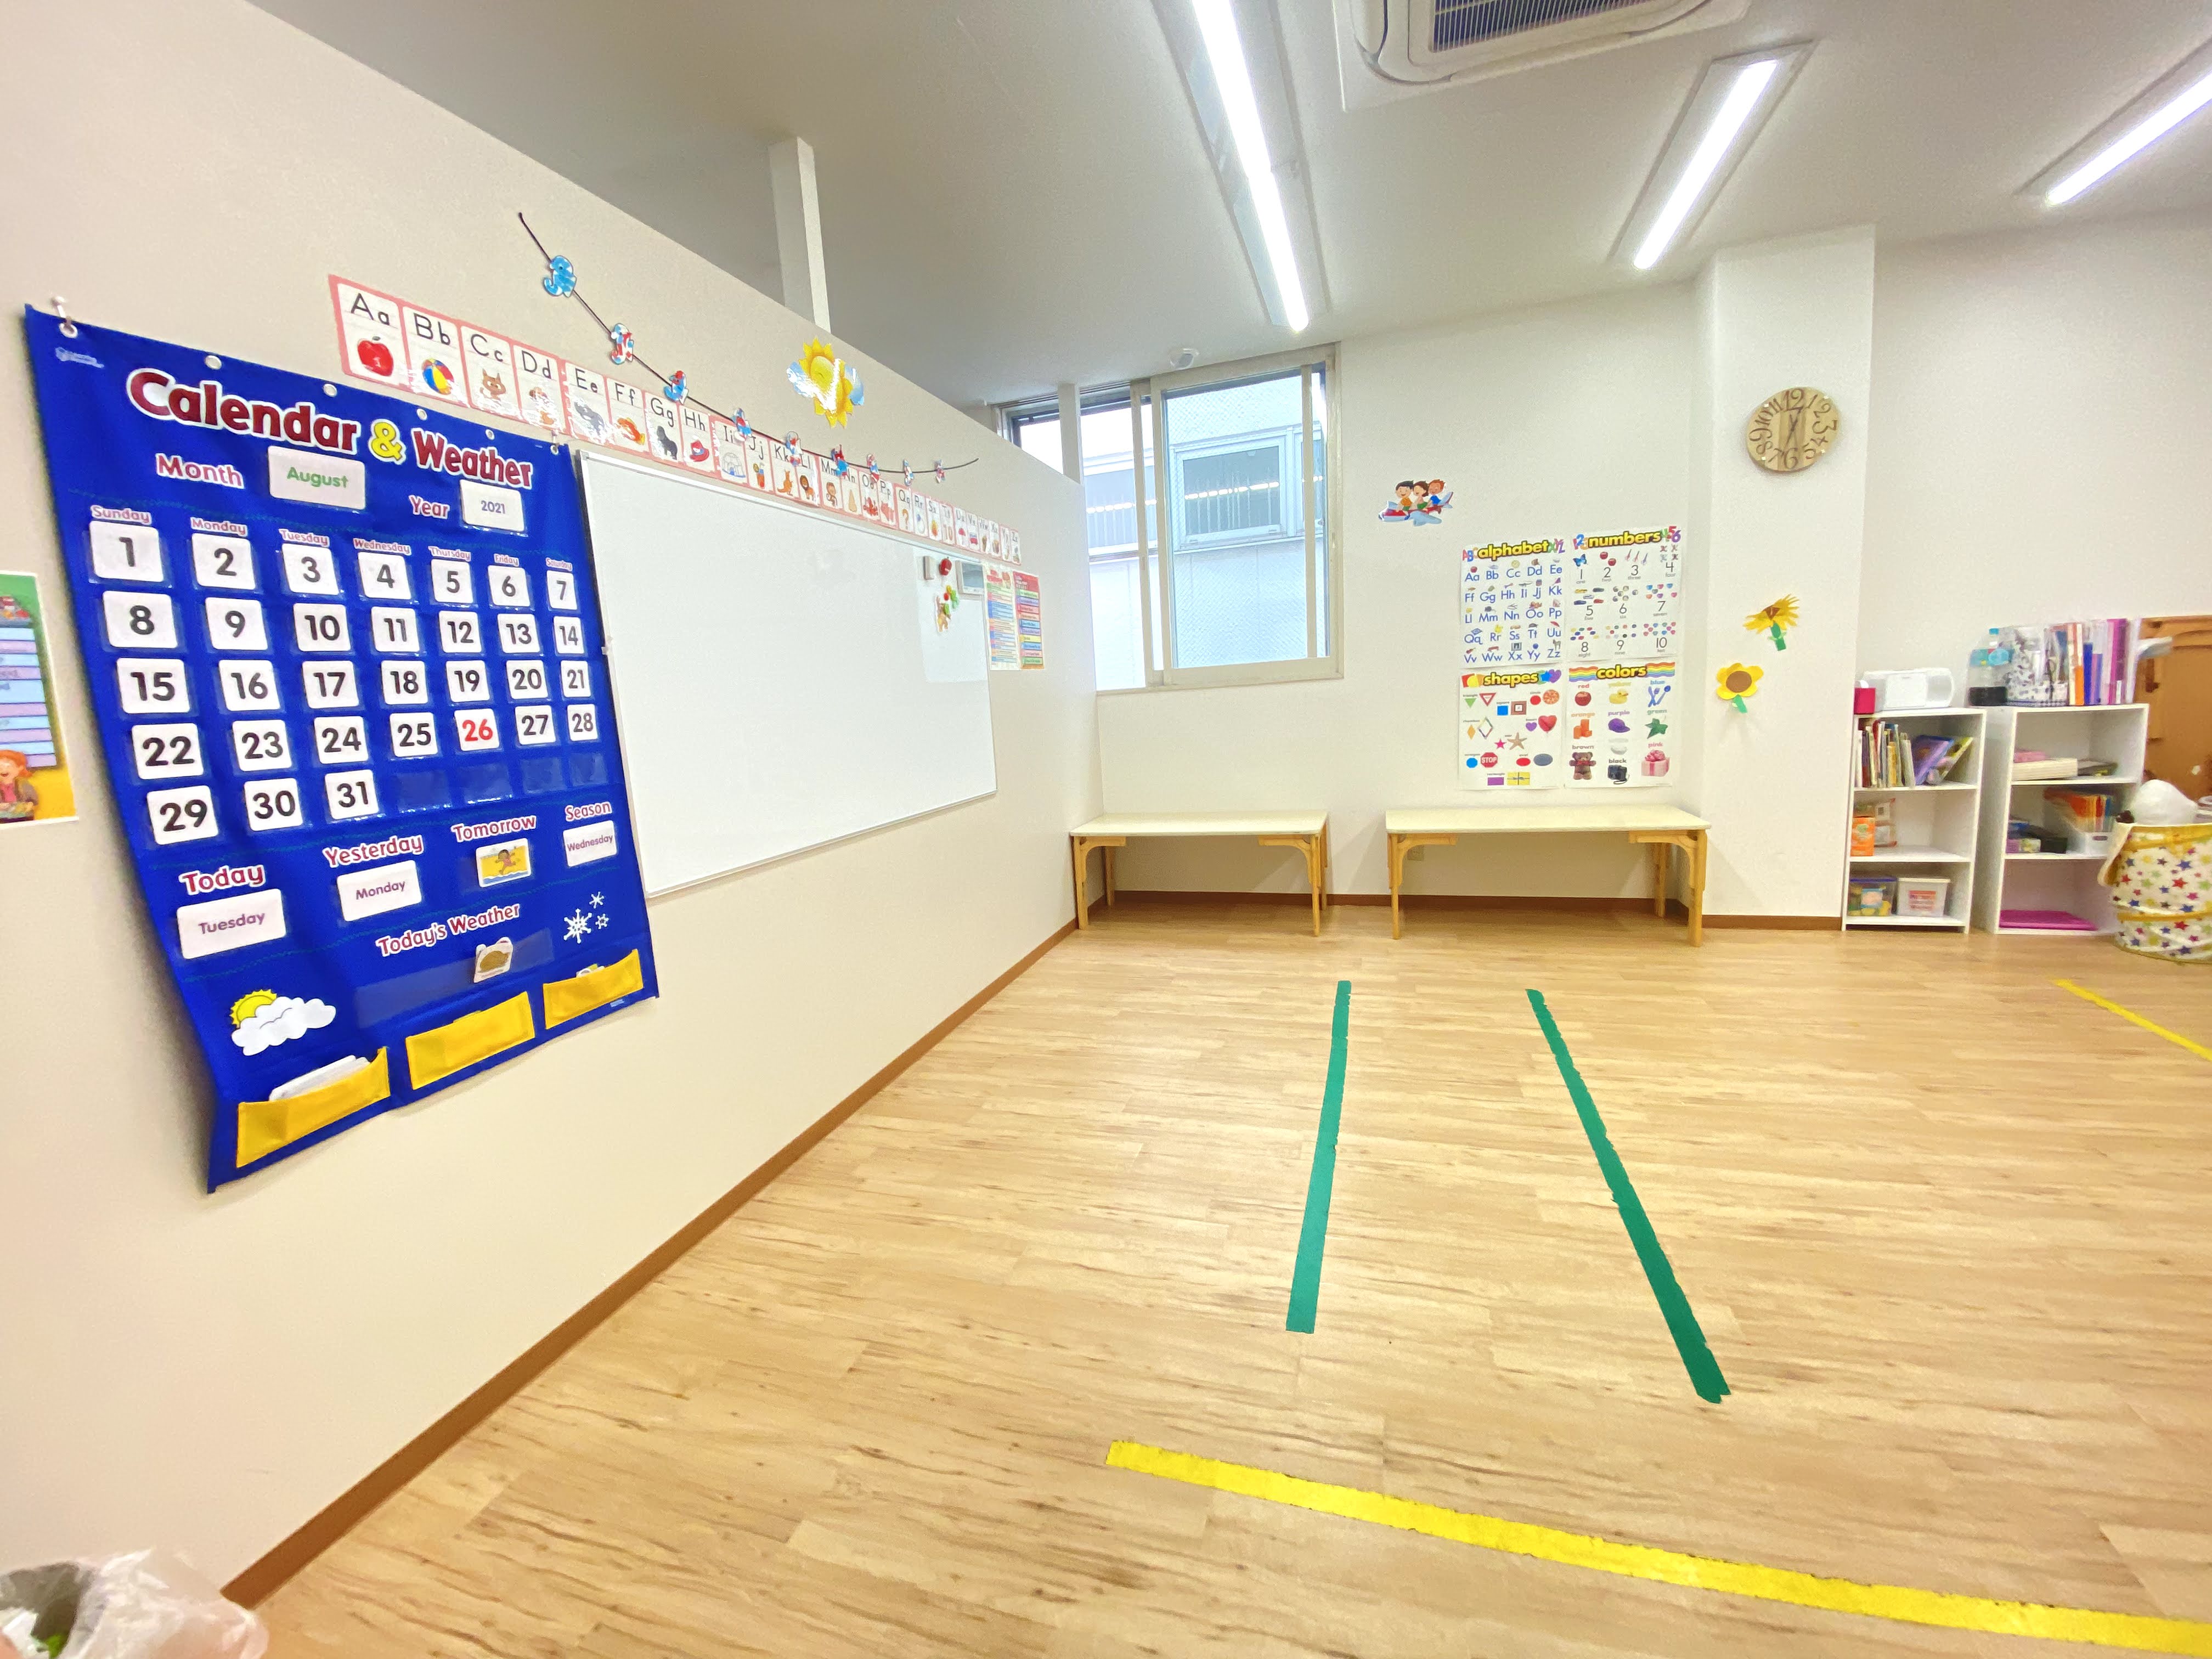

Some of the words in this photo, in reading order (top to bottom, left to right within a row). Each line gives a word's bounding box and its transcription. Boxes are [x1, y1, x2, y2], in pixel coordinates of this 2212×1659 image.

[127, 369, 359, 454] Calendar
[368, 419, 407, 465] &
[410, 427, 533, 489] Weather
[155, 453, 244, 488] Month
[286, 467, 348, 488] August
[408, 495, 449, 518] Year
[481, 500, 506, 514] 2021
[90, 505, 150, 524] Sunday
[191, 518, 247, 536] Monday
[279, 529, 329, 546] Tuesday
[353, 538, 411, 555] Wednesday
[428, 546, 471, 561] Thursday
[493, 554, 519, 567] Friday
[546, 557, 572, 571] Saturday
[1588, 531, 1662, 548] numbers
[1477, 540, 1550, 561] alphabet
[119, 537, 136, 567] 1
[213, 548, 237, 576] 2
[301, 556, 321, 583] 3
[376, 565, 395, 588] 4
[447, 571, 460, 592] 5
[501, 575, 516, 596] 6
[556, 580, 566, 600] 7
[1464, 573, 1480, 582] Aa
[1486, 571, 1499, 580] Bb
[1506, 568, 1521, 578] Cc
[1527, 566, 1542, 576] Dd
[1550, 565, 1562, 574] Ee
[1581, 569, 1583, 579] 1
[1604, 567, 1611, 578] 2
[1631, 565, 1638, 575] 3
[1666, 562, 1674, 572] 4
[1465, 593, 1475, 602] Ff
[1480, 592, 1496, 603] Gg
[1501, 590, 1515, 600] Hh
[1521, 589, 1527, 598] Ii
[1533, 588, 1541, 599] Jj
[1549, 586, 1562, 596] Kk
[1465, 614, 1472, 623] Ll
[1479, 613, 1498, 622] Mm
[1504, 611, 1519, 620] Nn
[1526, 609, 1543, 618] Oo
[1549, 608, 1562, 619] Pp
[1586, 605, 1593, 616] 5
[1620, 603, 1627, 614] 6
[1657, 601, 1666, 612] 7
[129, 605, 155, 635] 8
[225, 611, 245, 638] 9
[304, 615, 340, 640] 10
[383, 618, 407, 642] 11
[448, 622, 473, 643] 12
[506, 624, 532, 645] 13
[559, 626, 578, 646] 14
[1464, 634, 1483, 645] Qq
[1490, 633, 1501, 641] Rr
[1510, 631, 1520, 640] Ss
[1528, 629, 1537, 639] Tt
[1547, 628, 1561, 637] Uu
[1581, 642, 1588, 652] 8
[1617, 640, 1624, 650] 9
[1656, 637, 1667, 648] 10
[1464, 654, 1477, 663] Vv
[1482, 653, 1503, 662] Ww
[1509, 652, 1522, 661] Xx
[1527, 650, 1541, 662] Yy
[1547, 649, 1560, 658] Zz
[1483, 672, 1538, 688] shapes
[1596, 664, 1647, 679] colors
[131, 672, 176, 701] 15
[231, 673, 268, 699] 16
[313, 672, 346, 697] 17
[390, 670, 419, 694] 18
[454, 670, 479, 692] 19
[512, 669, 542, 690] 20
[567, 669, 584, 689] 21
[143, 736, 195, 766] 22
[241, 731, 283, 759] 23
[321, 727, 362, 753] 24
[397, 723, 431, 747] 25
[462, 719, 493, 742] 26
[522, 715, 548, 735] 27
[572, 713, 593, 732] 28
[160, 799, 207, 832] 29
[252, 791, 296, 819] 30
[337, 781, 368, 808] 31
[565, 801, 612, 821] Season
[451, 815, 537, 843] Tomorrow
[323, 834, 424, 868] Yesterday
[567, 834, 613, 851] Wednesday
[179, 865, 265, 895] Today
[356, 881, 405, 900] Monday
[199, 913, 265, 934] Tuesday
[376, 923, 448, 957] Today's
[448, 903, 520, 935] Weather
